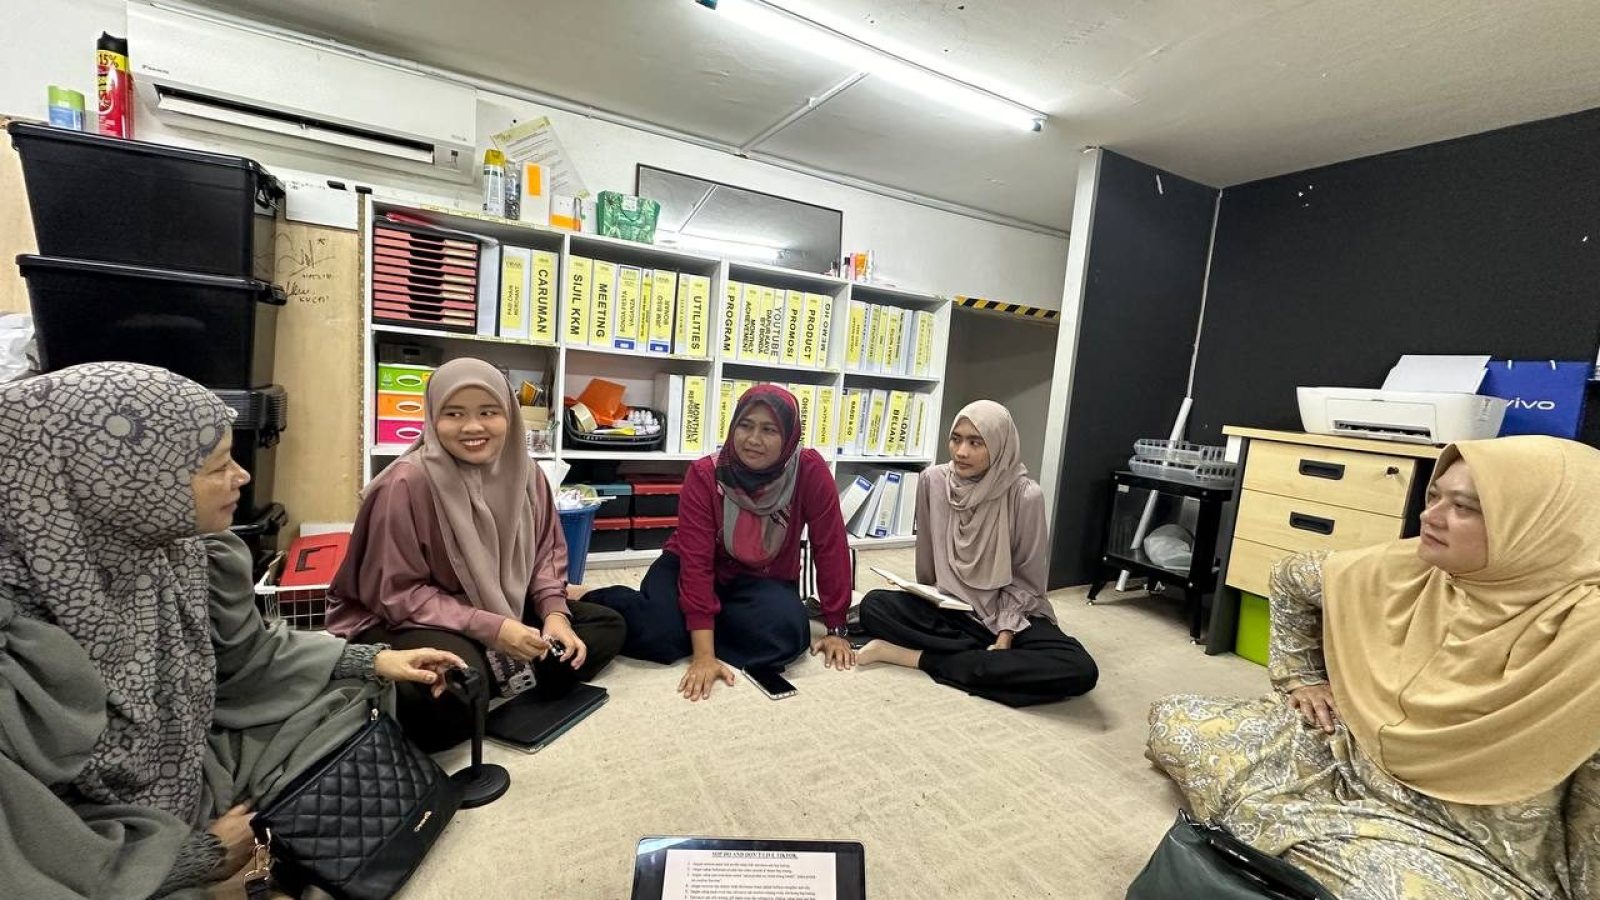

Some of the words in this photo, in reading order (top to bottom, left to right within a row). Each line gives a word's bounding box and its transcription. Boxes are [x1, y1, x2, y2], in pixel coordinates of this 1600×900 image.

[98, 54, 120, 68] 15%
[536, 269, 548, 333] CARUMAN
[572, 274, 583, 302] SIJIL
[596, 283, 608, 338] MEETING
[570, 308, 580, 335] KKM
[691, 296, 702, 349] UTILITIES
[723, 295, 735, 351] PROGRAM
[742, 301, 752, 353] ACHIEVEMENT
[748, 319, 756, 354] MONTHLY
[764, 310, 772, 334] DAPUR
[771, 307, 782, 357] YOUTUBE
[787, 308, 798, 357] PROMOSI
[804, 309, 816, 360] PRODUCT
[692, 403, 700, 444] MONTHLY
[888, 409, 899, 443] BELIAN
[899, 417, 909, 442] LOAN
